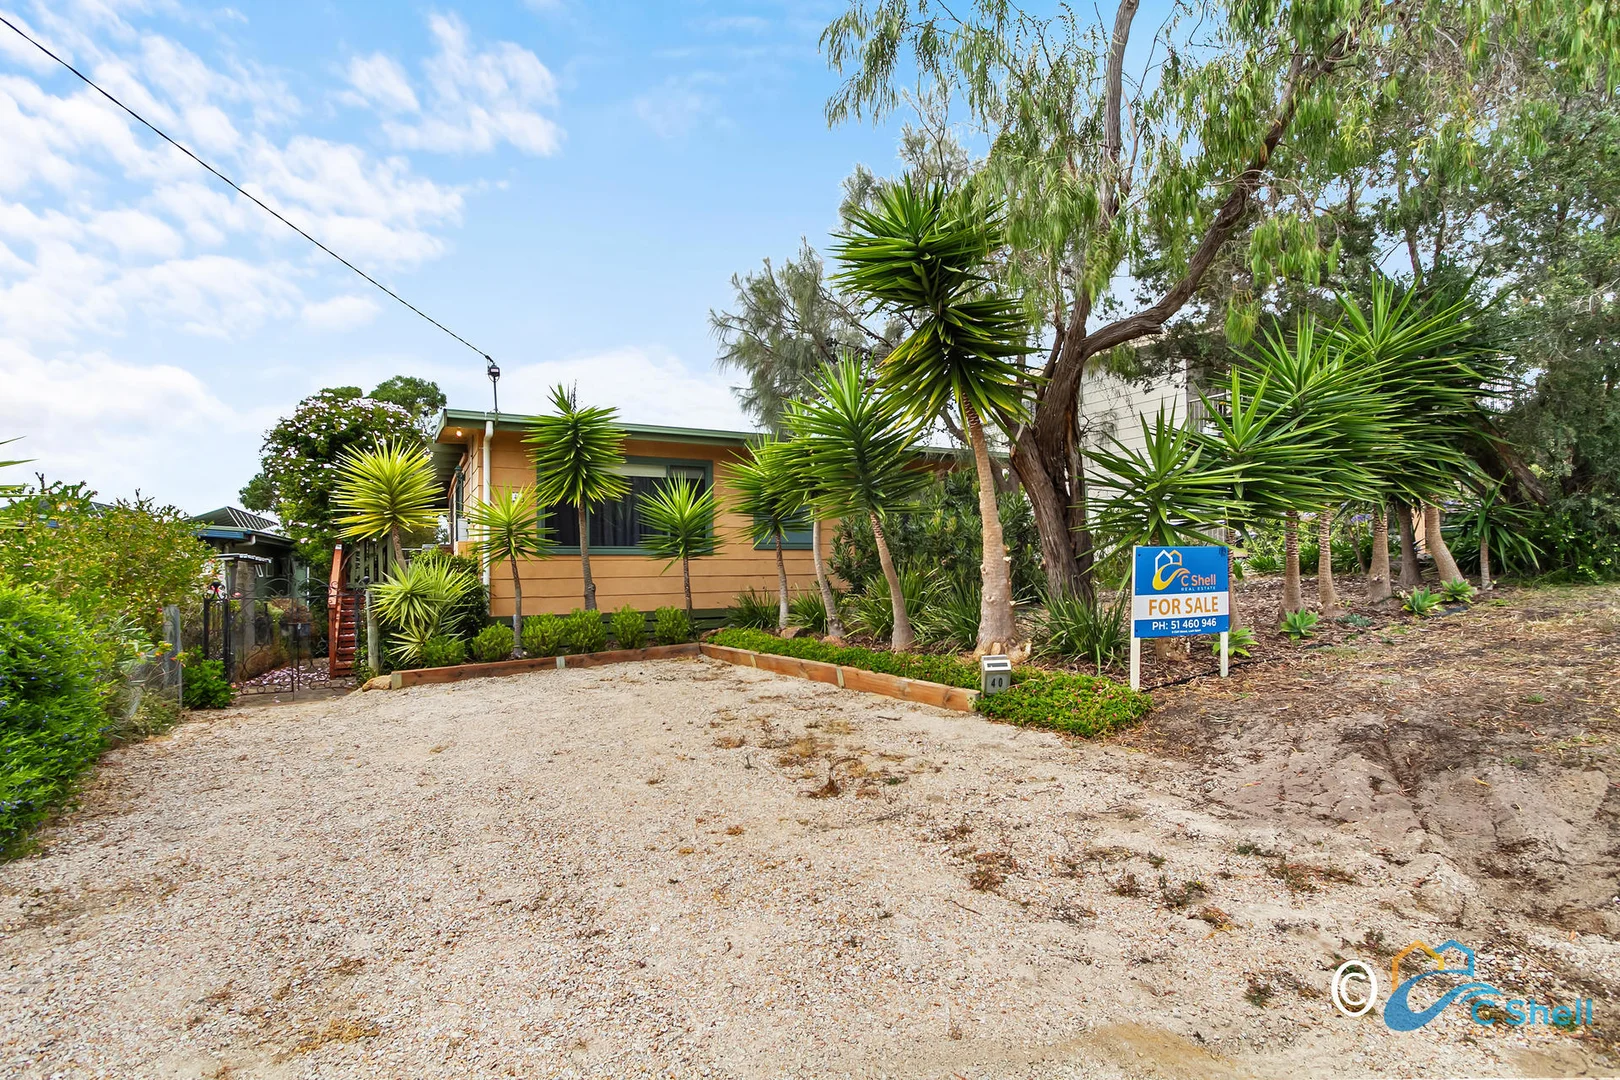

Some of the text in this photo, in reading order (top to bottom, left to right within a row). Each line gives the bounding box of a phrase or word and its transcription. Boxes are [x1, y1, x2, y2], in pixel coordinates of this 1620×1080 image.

[1181, 574, 1216, 587] C Shell
[1148, 596, 1219, 616] FOR SALE
[1152, 618, 1217, 631] PH: 51 460 946
[991, 677, 1003, 688] 40
